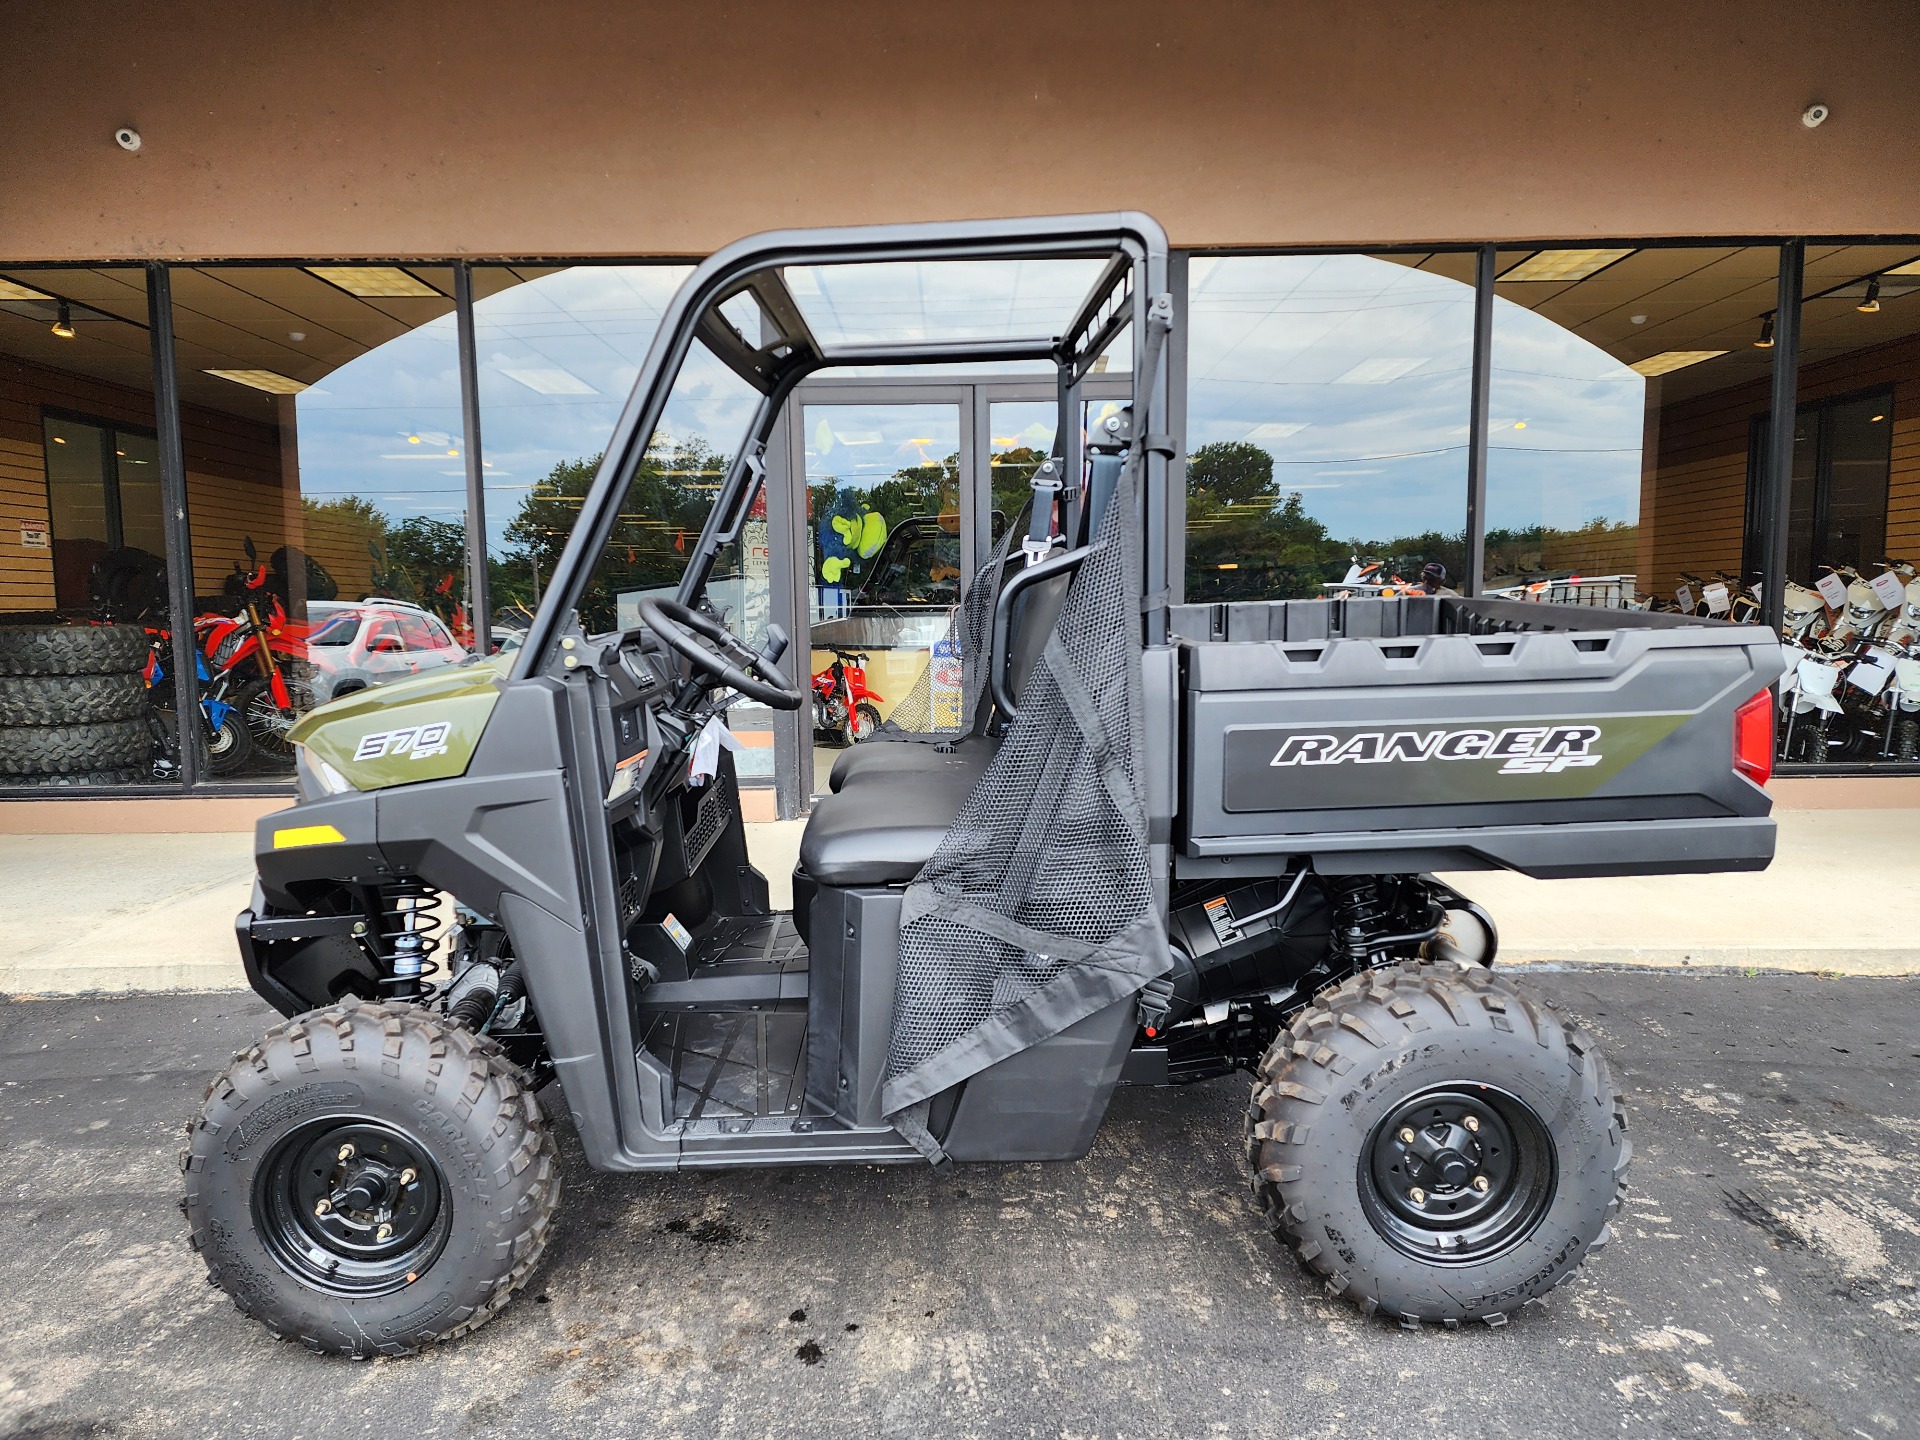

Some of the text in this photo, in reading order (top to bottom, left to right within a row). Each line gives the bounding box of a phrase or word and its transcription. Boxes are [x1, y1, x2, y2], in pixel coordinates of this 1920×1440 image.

[353, 721, 451, 761] 570
[409, 745, 448, 760] EFI
[1269, 725, 1602, 767] RANGER
[1497, 754, 1603, 775] SP
[1464, 1234, 1580, 1311] CARLISLE
